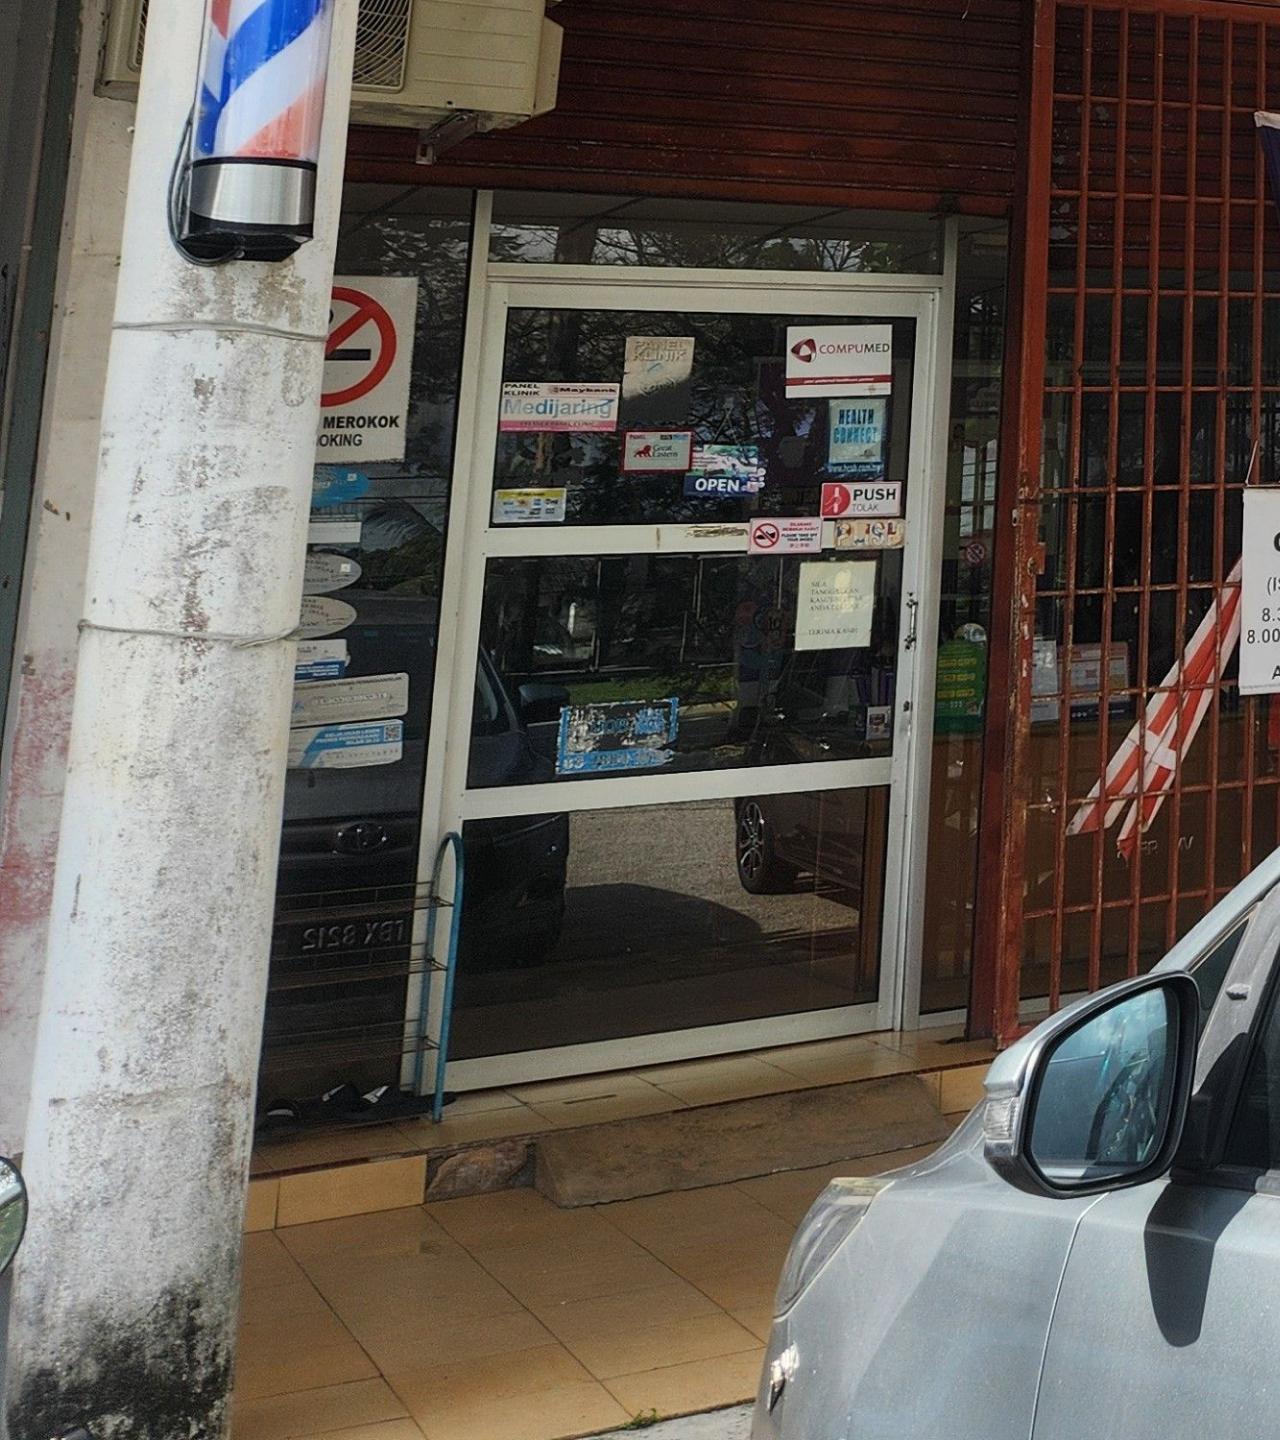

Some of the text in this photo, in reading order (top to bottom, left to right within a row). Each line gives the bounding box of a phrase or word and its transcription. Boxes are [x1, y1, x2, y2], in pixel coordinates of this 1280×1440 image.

[819, 343, 890, 355] COMPUMED
[503, 398, 614, 418] Medijaring
[322, 415, 400, 430] MEROKOK
[838, 408, 875, 425] HEALTH
[317, 433, 363, 448] OKING
[695, 477, 740, 493] OPEN
[852, 488, 897, 502] PUSH
